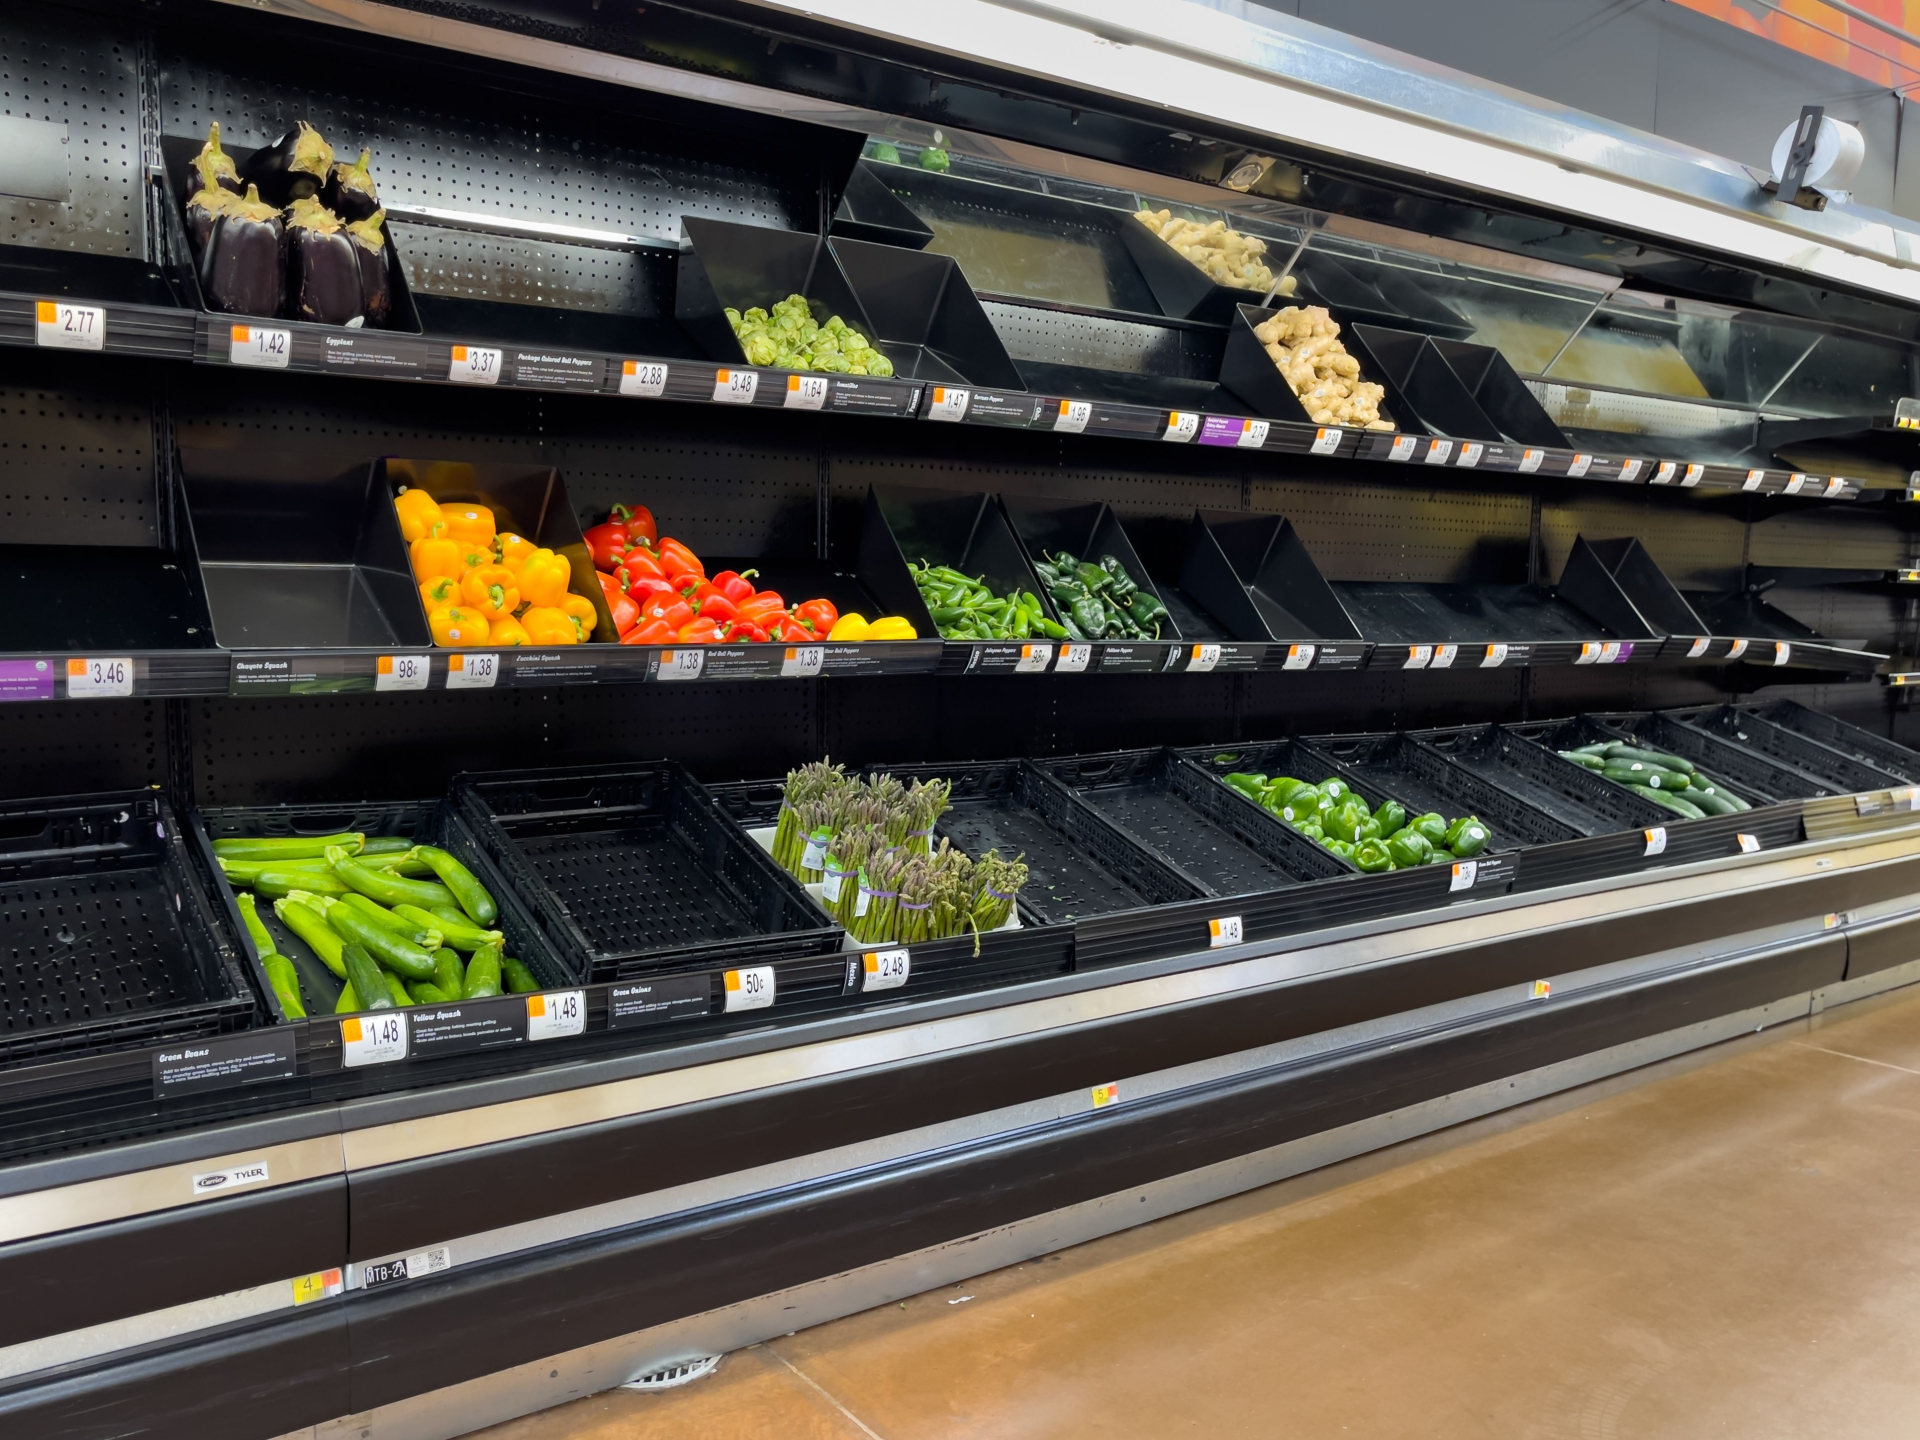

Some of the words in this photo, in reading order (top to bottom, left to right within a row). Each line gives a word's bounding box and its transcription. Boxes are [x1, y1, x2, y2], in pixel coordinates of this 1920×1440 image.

[61, 309, 95, 333] $2.77
[255, 331, 285, 354] $1.42
[326, 336, 354, 347] Eggplant
[571, 358, 593, 367] Peppers
[908, 389, 920, 412] Panama
[236, 662, 263, 671] Chayote
[263, 661, 288, 671] Squash
[541, 654, 561, 662] Squash
[650, 661, 658, 673] USA
[90, 662, 124, 684] $3.46
[847, 962, 858, 987] Mexico
[880, 956, 904, 977] $2.48
[612, 988, 630, 997] Green
[630, 986, 652, 995] Onions
[746, 972, 764, 995] 50¢
[413, 1014, 436, 1023] Yellow
[436, 1009, 462, 1021] Squash
[548, 996, 577, 1021] $1.48
[365, 1018, 399, 1046] $1.48
[159, 1053, 183, 1063] Green
[184, 1049, 210, 1059] Beans
[234, 1168, 265, 1180] TYLER
[366, 1261, 407, 1284] MTB-2A
[303, 1276, 314, 1291] 4
